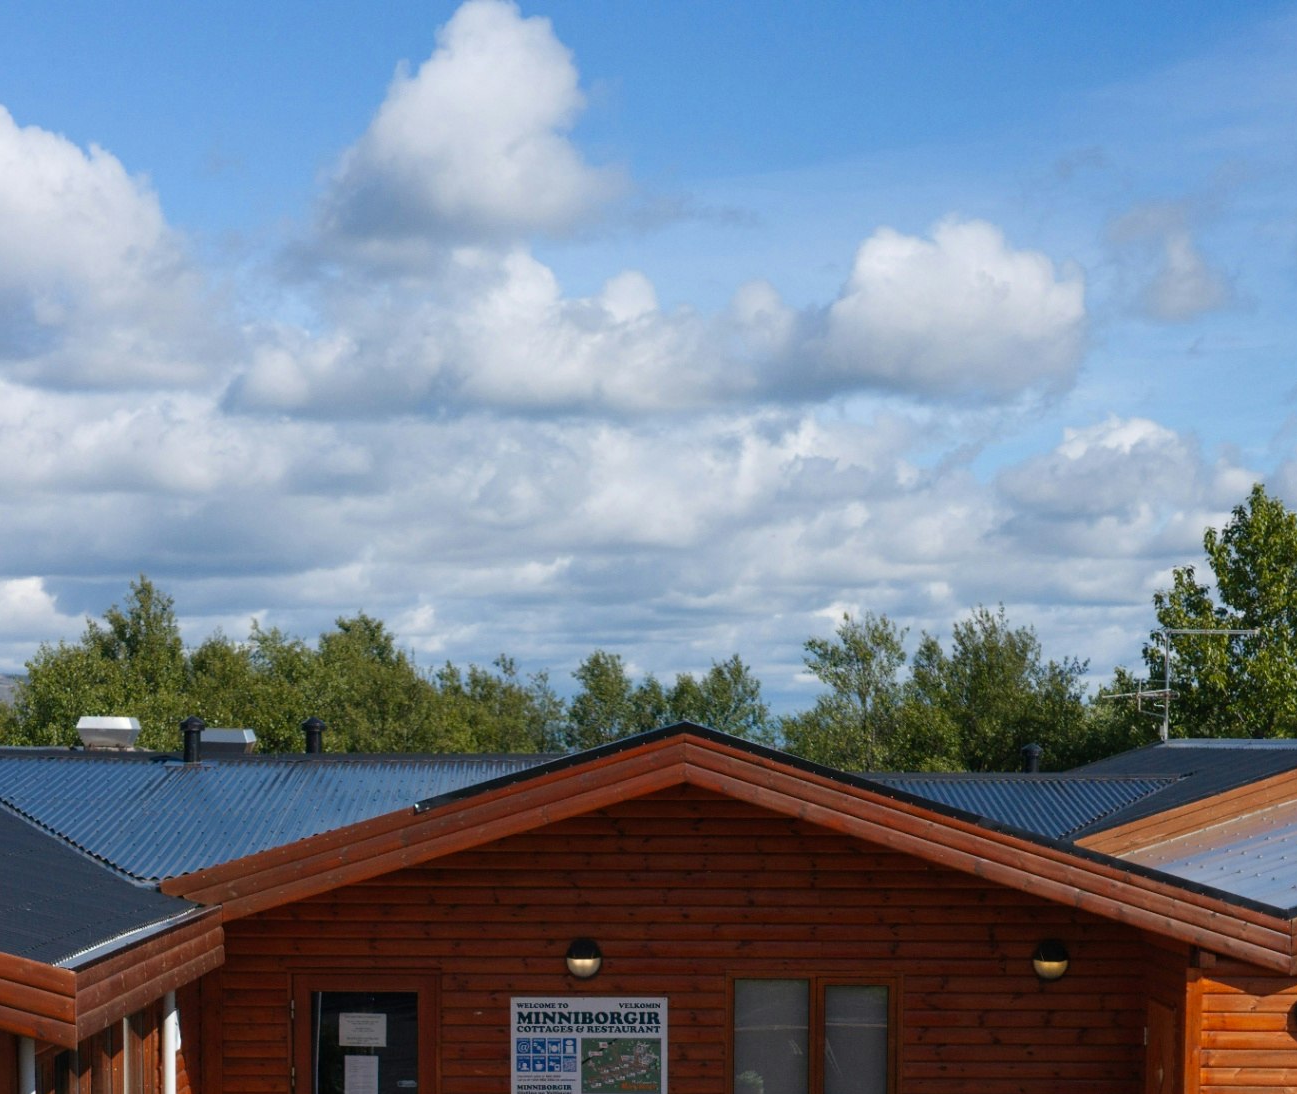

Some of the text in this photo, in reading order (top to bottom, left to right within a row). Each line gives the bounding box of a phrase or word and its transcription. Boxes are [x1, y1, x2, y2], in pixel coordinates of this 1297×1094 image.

[517, 1011, 661, 1025] MINNIBORGIR
[517, 1025, 661, 1033] COTTAGES & RESTAURANT
